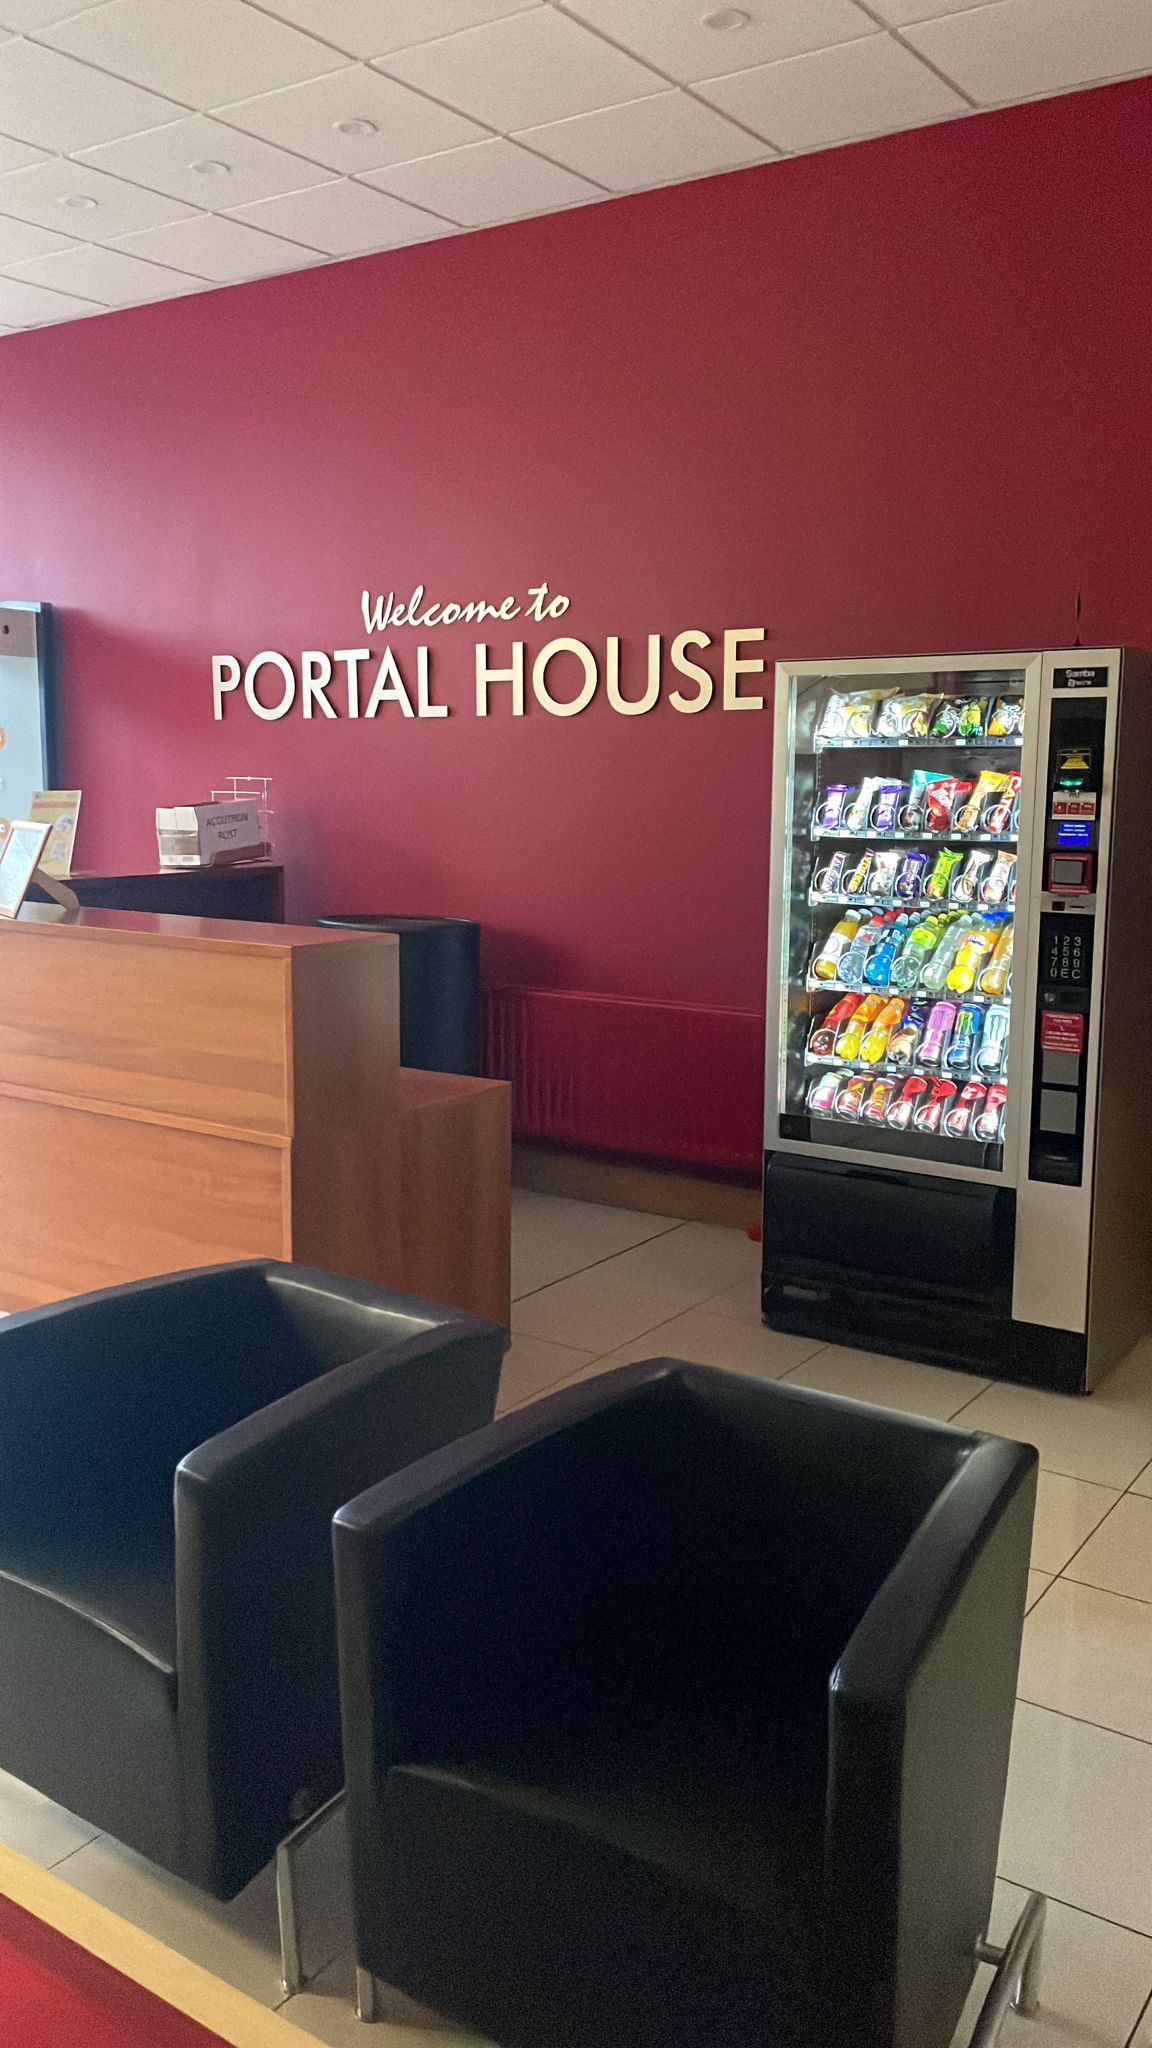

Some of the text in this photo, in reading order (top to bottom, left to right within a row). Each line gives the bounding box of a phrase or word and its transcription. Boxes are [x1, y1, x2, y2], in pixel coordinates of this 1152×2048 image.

[361, 582, 571, 634] Welcome to
[211, 627, 767, 722] PORTAL HOUSE
[1054, 935, 1082, 946] 1 2 3
[1062, 946, 1070, 956] 5
[1073, 947, 1081, 957] 6
[1051, 956, 1080, 968] 7 8 9
[1050, 967, 1081, 979] 0 E C
